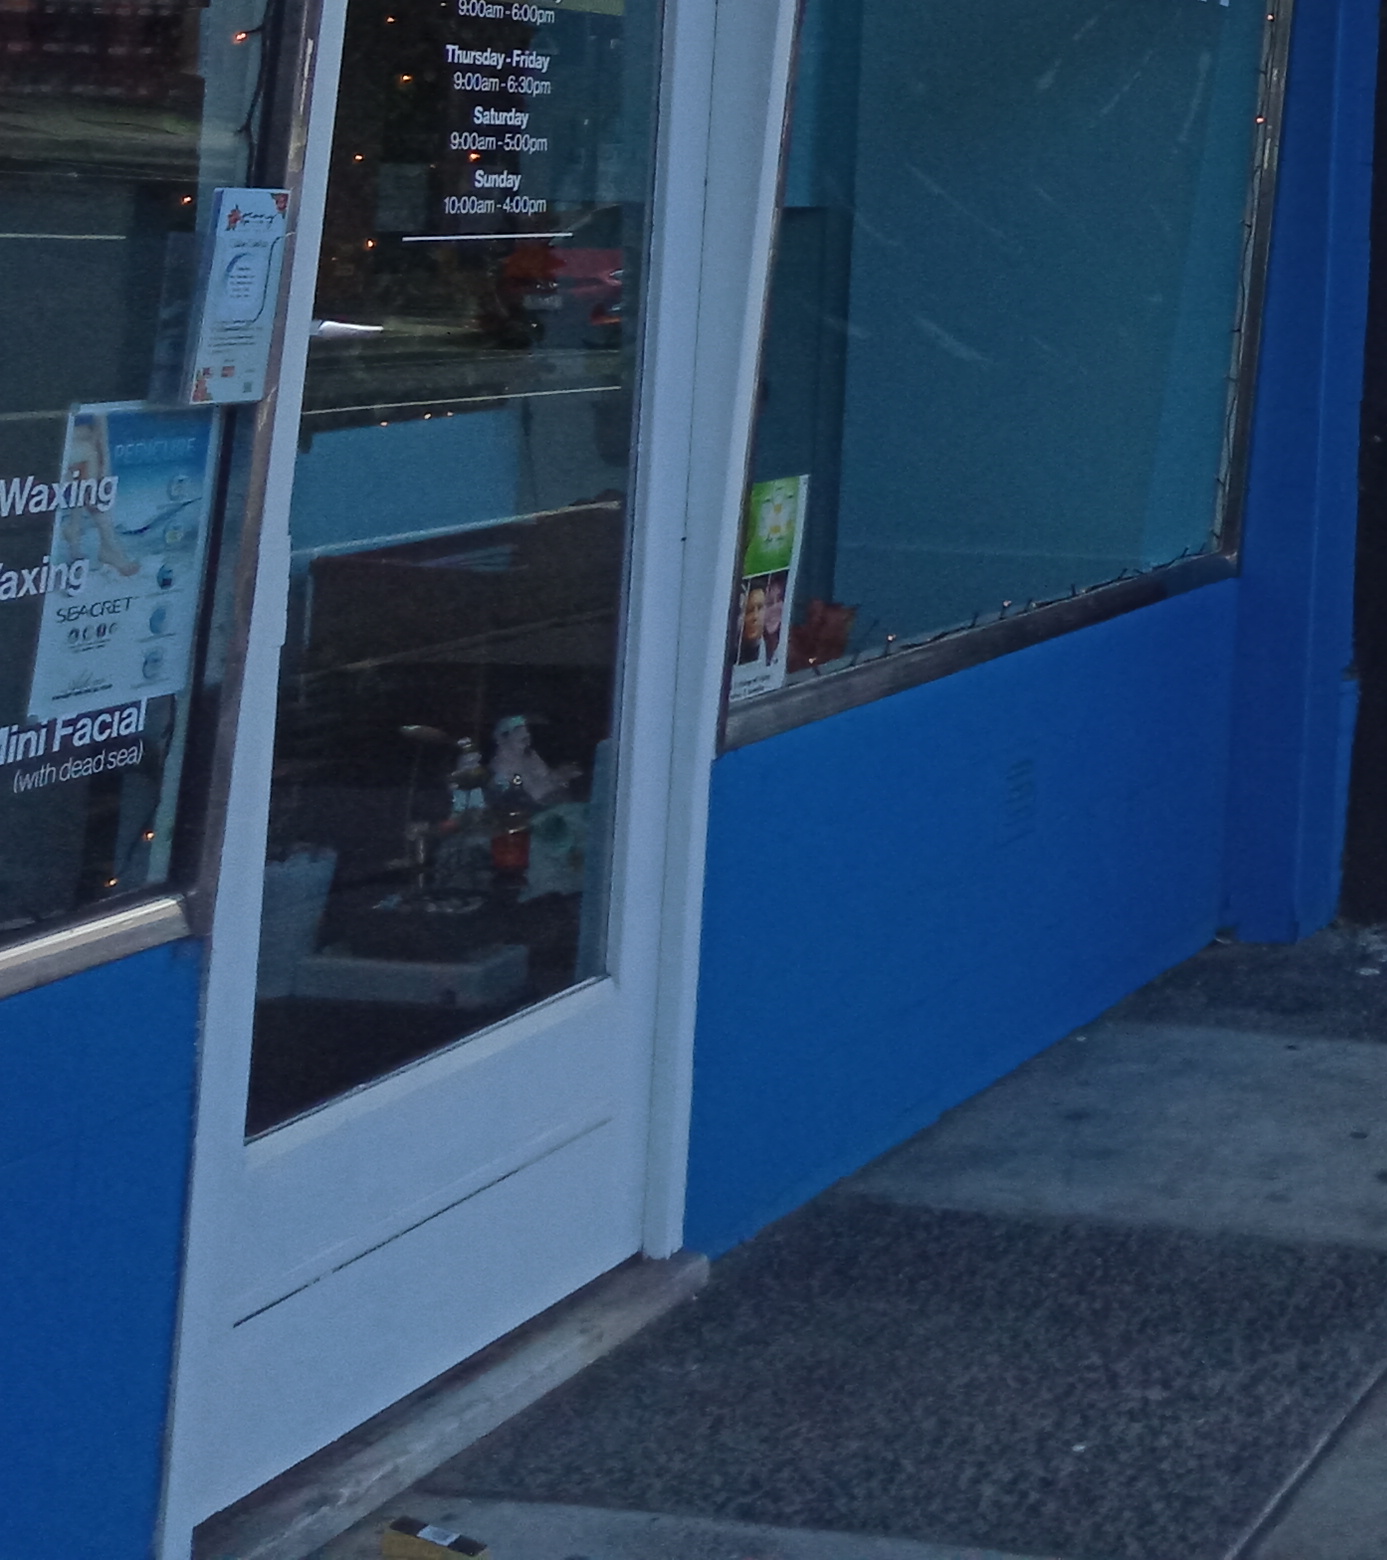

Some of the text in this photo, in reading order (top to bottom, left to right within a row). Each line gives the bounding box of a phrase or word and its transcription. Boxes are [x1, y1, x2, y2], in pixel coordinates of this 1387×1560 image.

[473, 105, 529, 130] Saturday
[474, 169, 522, 192] Sunday
[0, 470, 119, 518] Waxing
[0, 555, 91, 602] axing
[55, 595, 133, 624] SEACRET
[52, 696, 148, 753] Facial
[13, 739, 145, 794] (with dead sea)
